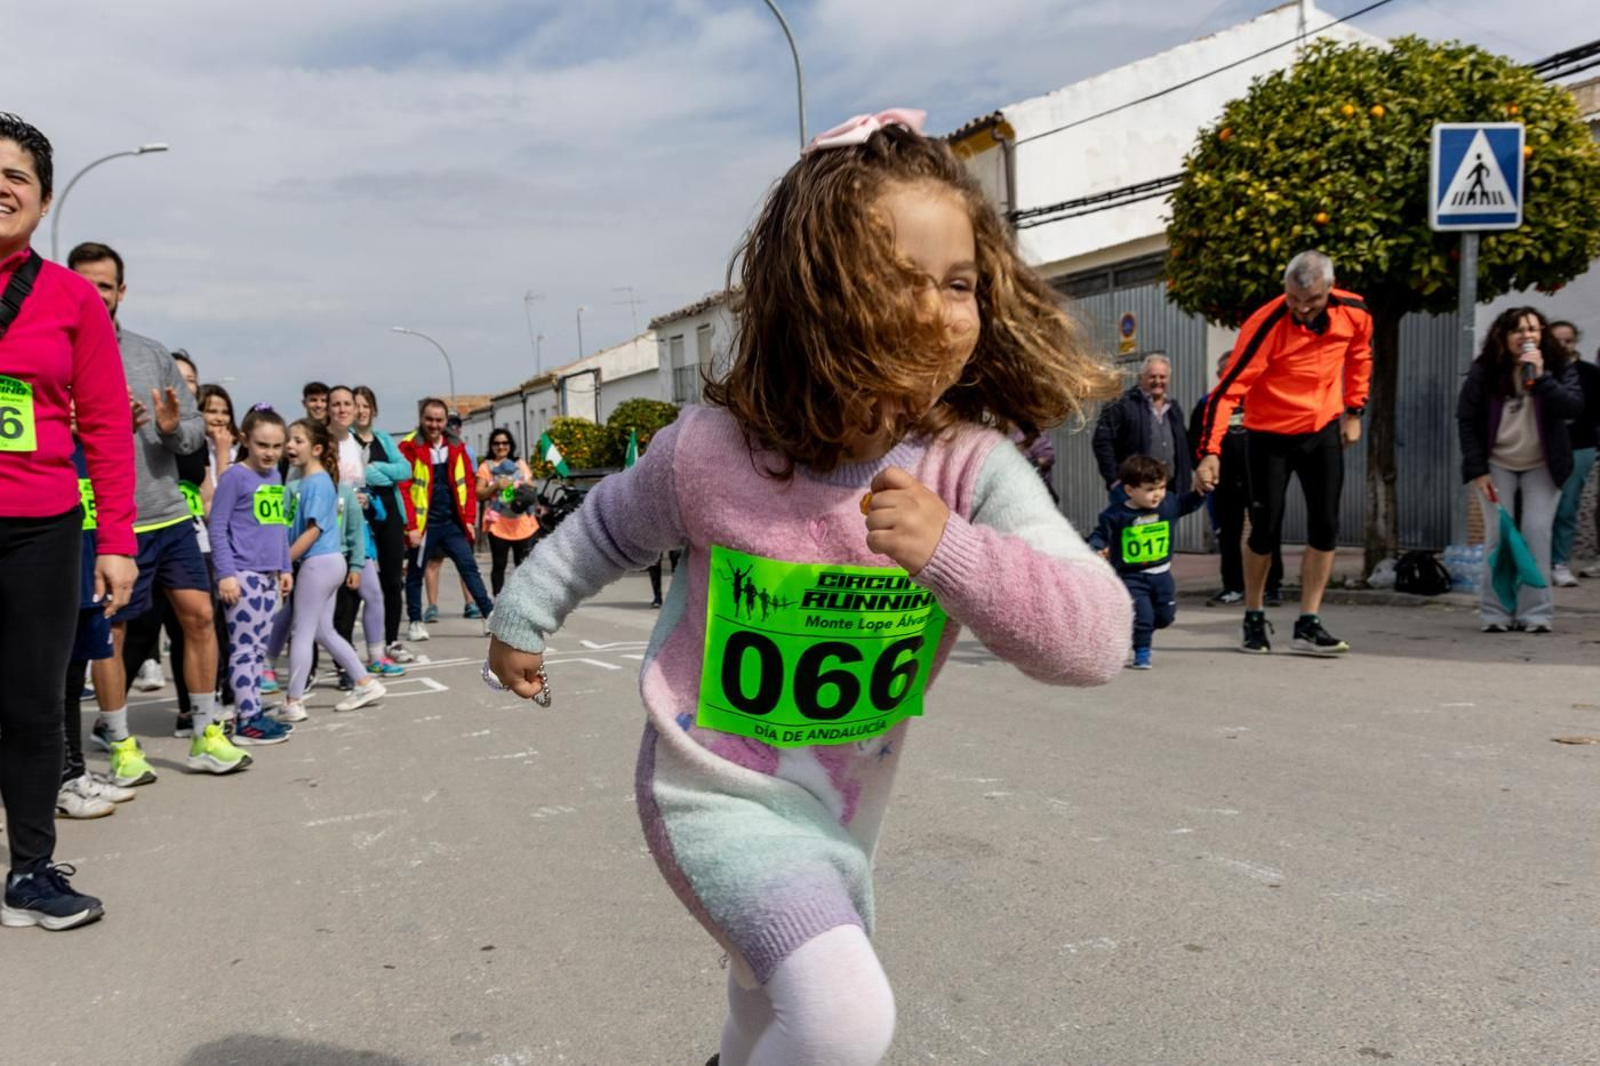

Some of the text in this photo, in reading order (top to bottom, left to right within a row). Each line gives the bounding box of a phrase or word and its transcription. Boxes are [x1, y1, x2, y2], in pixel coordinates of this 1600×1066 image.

[259, 499, 284, 518] 01
[1127, 536, 1166, 558] 017
[817, 573, 921, 590] CIRCUI
[801, 591, 937, 611] RUNNIN
[805, 615, 854, 630] Monte
[858, 617, 892, 633] Lope
[721, 631, 925, 720] 066
[754, 719, 887, 742] DÍA DE ANDALUCÍA
